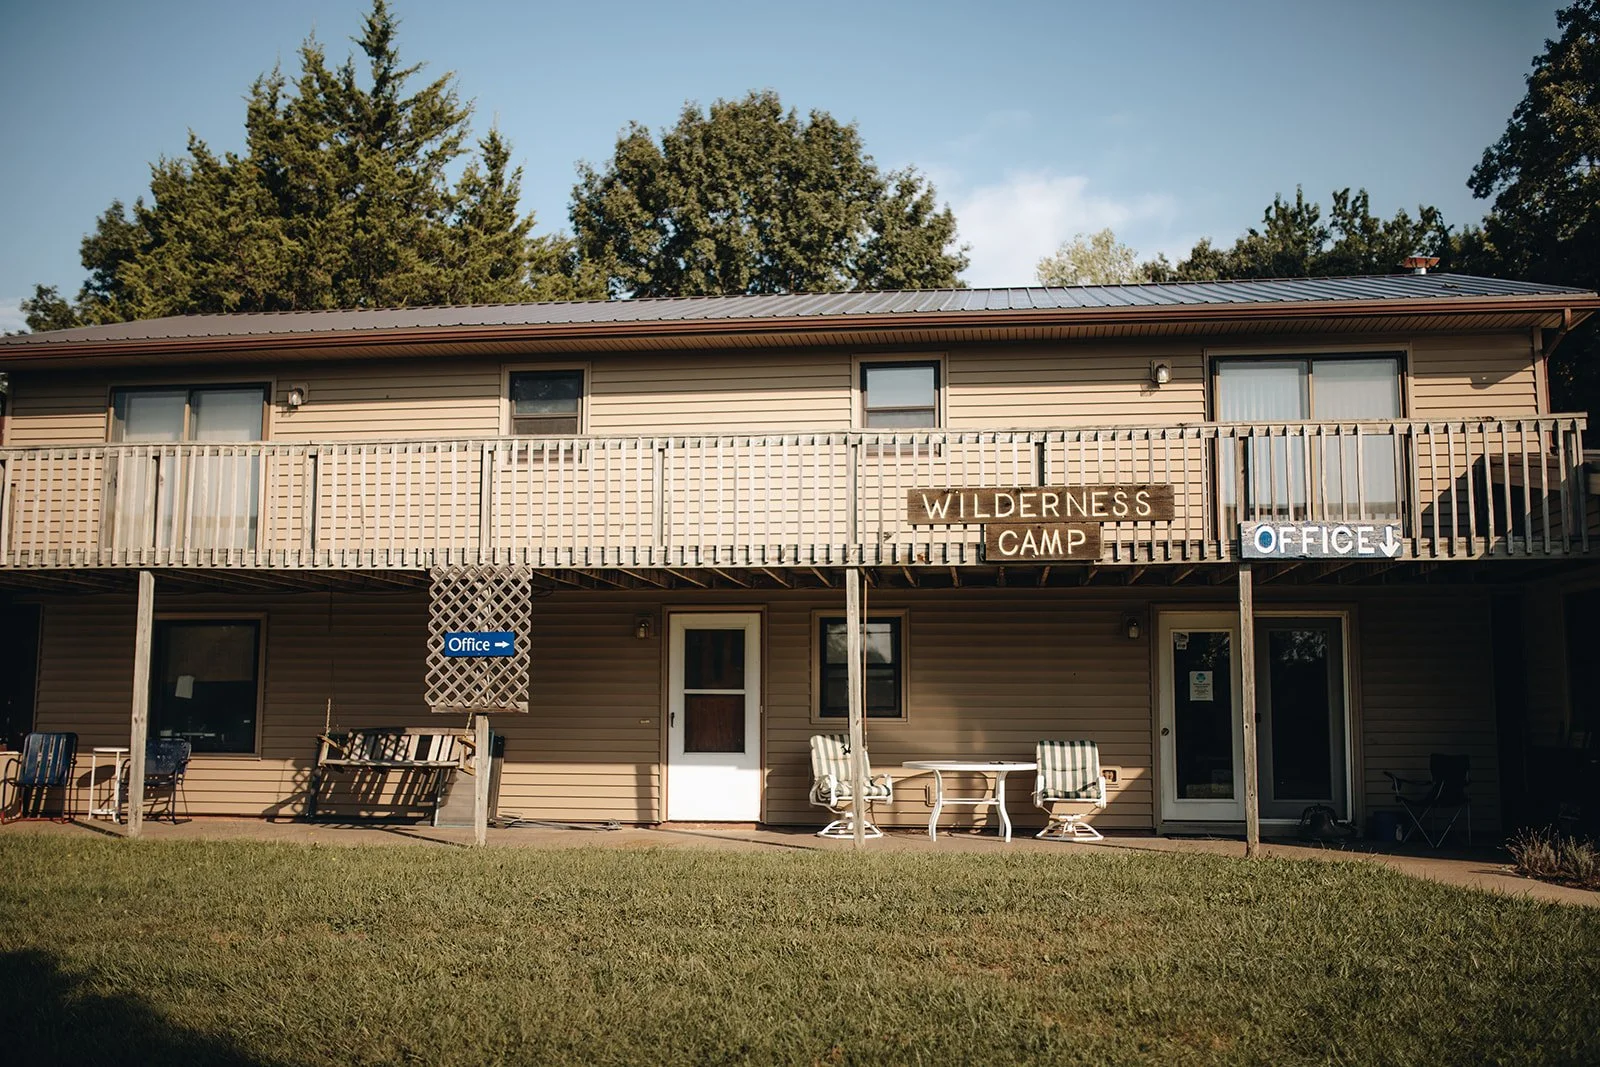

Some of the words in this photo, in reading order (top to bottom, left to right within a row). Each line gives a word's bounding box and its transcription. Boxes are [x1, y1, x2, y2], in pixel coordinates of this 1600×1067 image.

[921, 491, 1152, 519] WILDERNESS
[998, 530, 1086, 556] CAMP
[1253, 525, 1376, 554] OFFICE
[448, 637, 490, 651] Office
